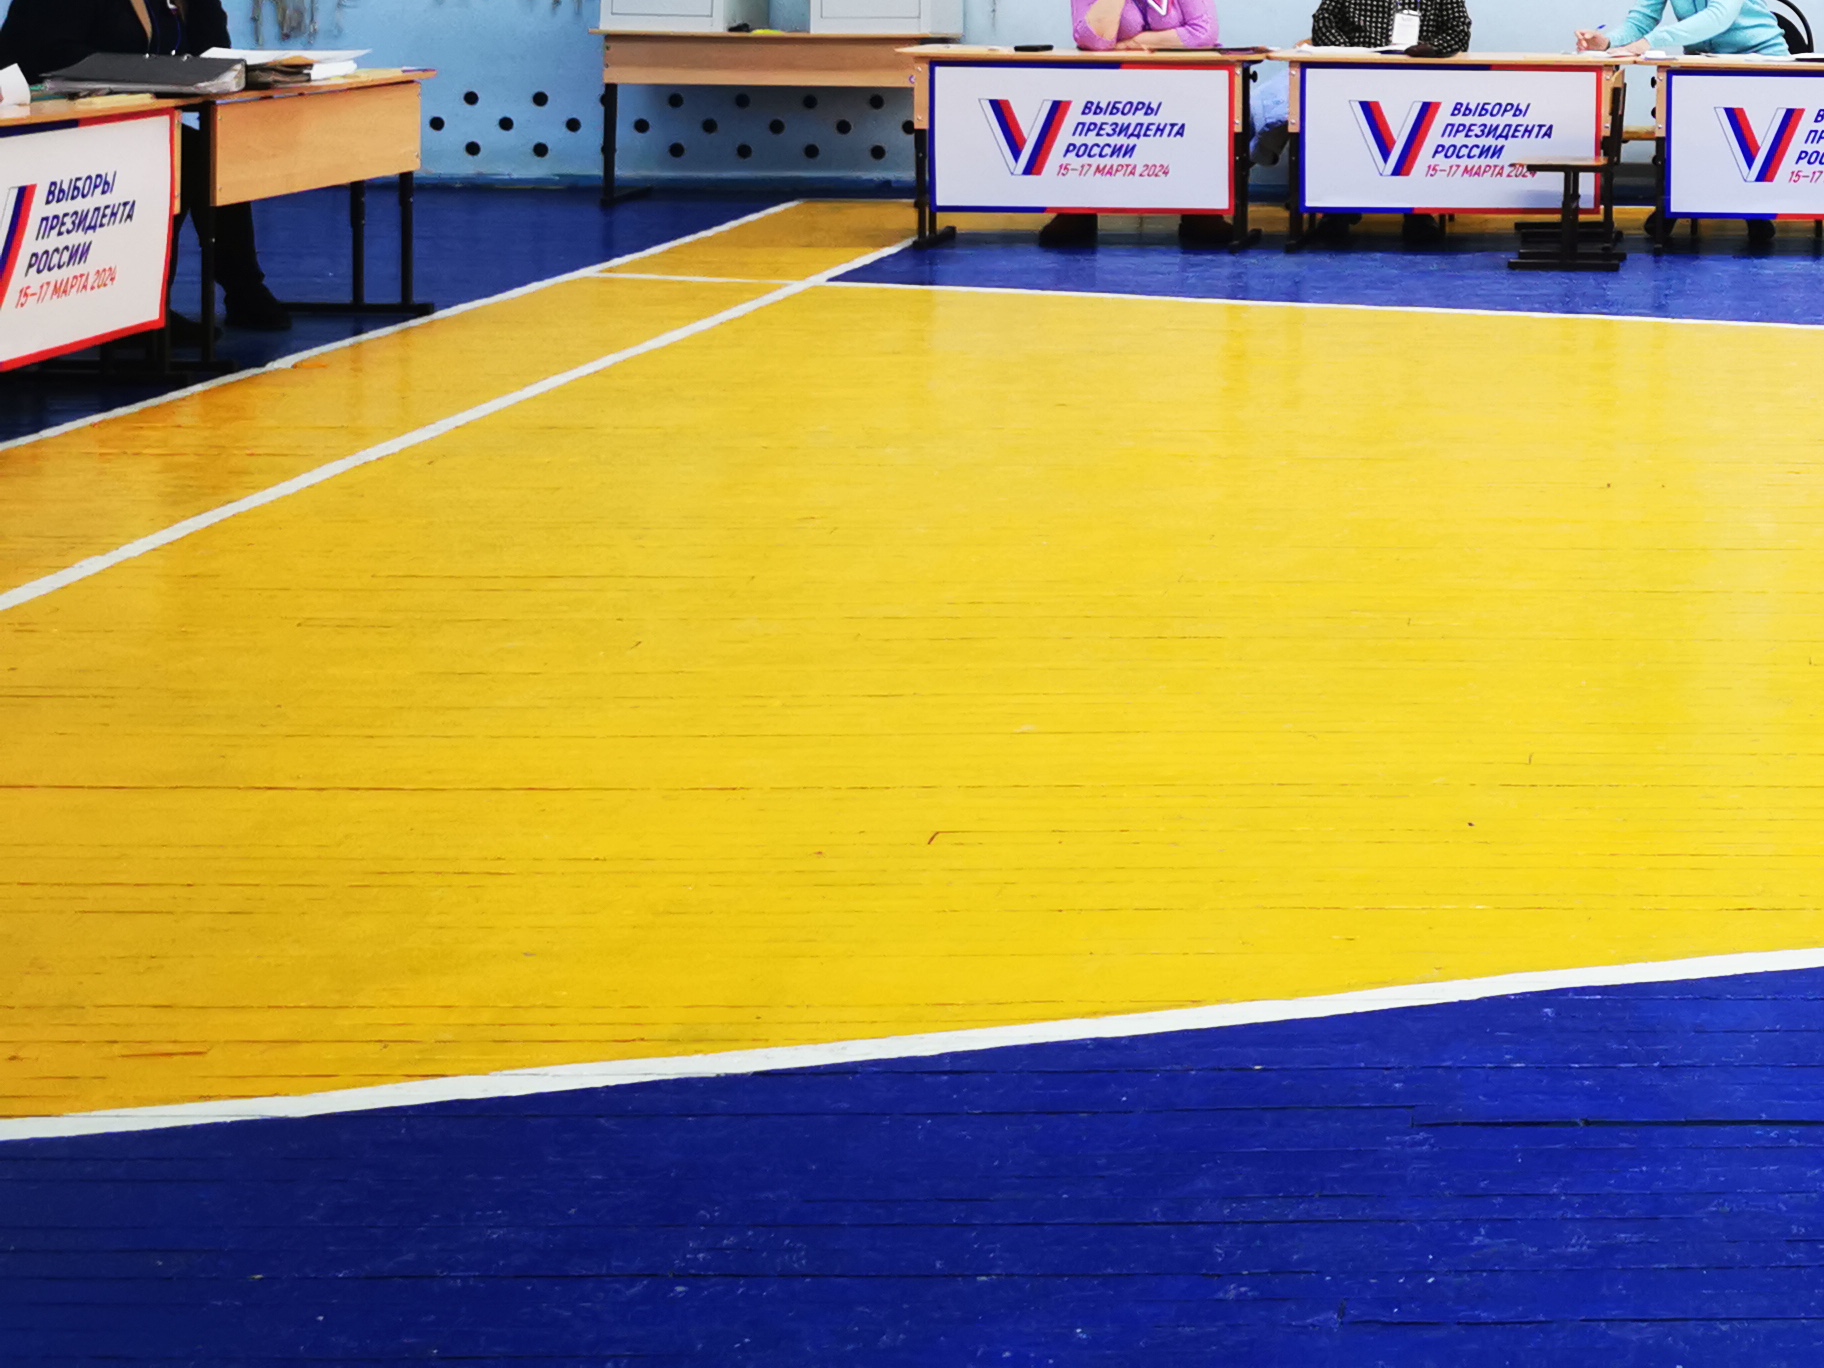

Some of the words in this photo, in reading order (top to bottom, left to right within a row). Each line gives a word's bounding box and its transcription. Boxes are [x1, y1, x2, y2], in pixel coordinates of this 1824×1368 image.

[1081, 100, 1162, 116] ВЫБОРЫ
[1450, 102, 1531, 117] ВЫБОРЫ
[1072, 122, 1186, 140] ПРЕЗИДЕНТА
[1441, 123, 1553, 141] ПРЕЗИДЕНТА
[1063, 143, 1137, 158] РОССИИ
[1432, 144, 1505, 159] РОССИИ
[1093, 164, 1137, 178] МАРТА
[1138, 164, 1170, 178] 2024
[1461, 164, 1504, 178] МАРТА
[45, 170, 117, 205] ВЫБОРЫ
[35, 200, 136, 241] ПРЕЗИДЕНТА
[25, 240, 93, 277] РОССИИ
[50, 271, 91, 300] МАРТА
[90, 265, 118, 292] 2024
